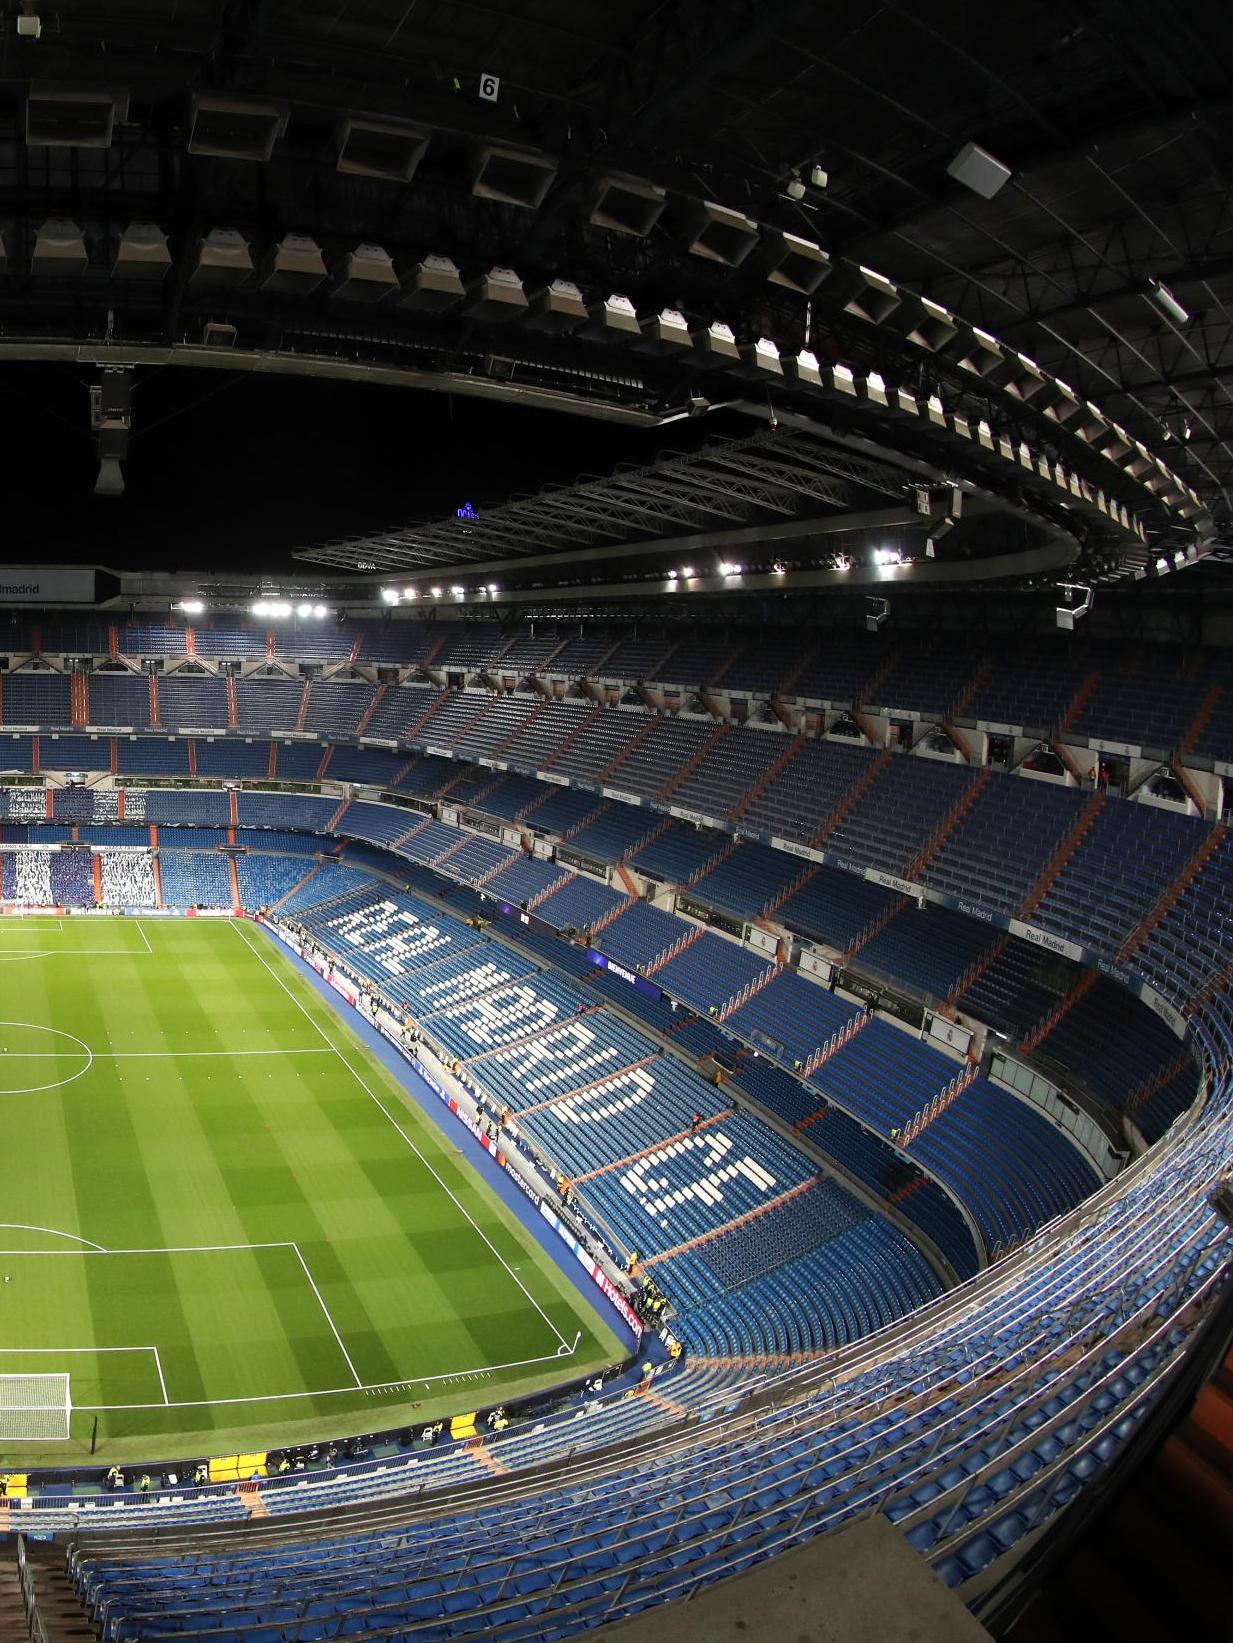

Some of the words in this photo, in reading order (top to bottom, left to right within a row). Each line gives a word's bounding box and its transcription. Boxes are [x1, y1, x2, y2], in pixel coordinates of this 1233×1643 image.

[483, 78, 495, 96] 6
[958, 902, 971, 913] Real
[972, 907, 993, 922] Madrid
[1026, 930, 1041, 942] Real
[1042, 936, 1065, 952] Madrid
[608, 960, 636, 984] BIENVENUE
[419, 962, 656, 1124] MADRID
[505, 1163, 540, 1205] mastercard
